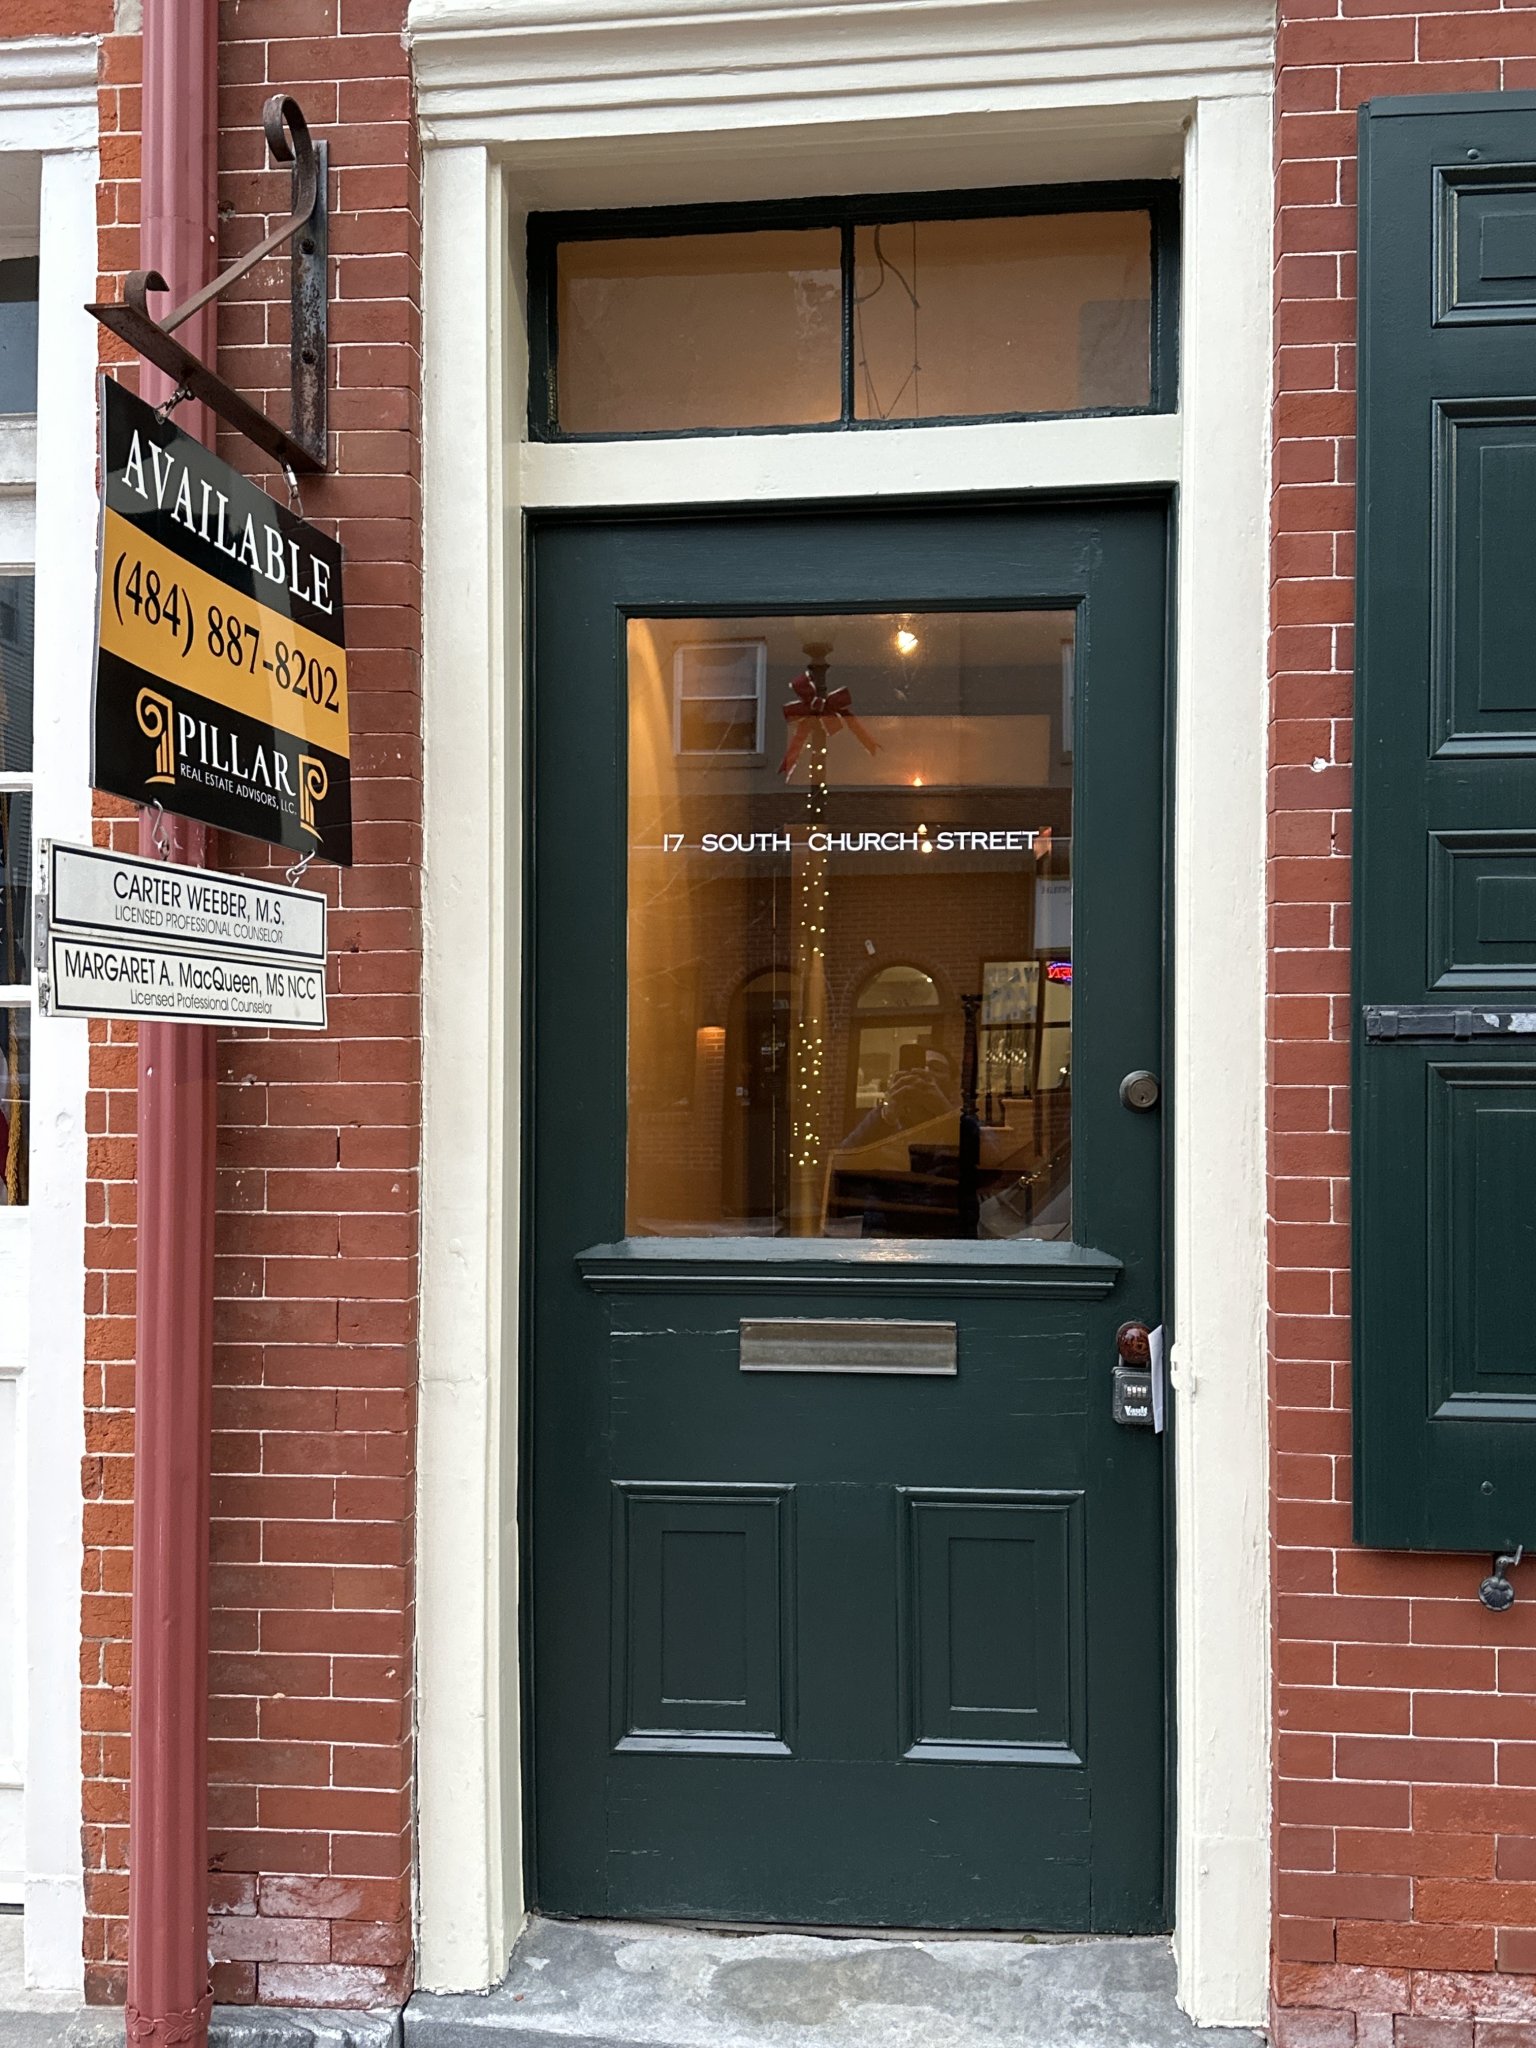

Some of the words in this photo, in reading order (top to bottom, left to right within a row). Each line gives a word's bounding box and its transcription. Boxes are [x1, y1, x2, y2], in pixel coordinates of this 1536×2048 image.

[121, 429, 333, 616] AVAILABLE
[113, 552, 194, 658] (484)
[207, 605, 340, 714] 887-8202
[177, 711, 296, 797] PILLAR
[180, 763, 203, 783] REAL
[205, 769, 234, 793] ESTATE
[236, 785, 279, 811] ADVISORS,
[280, 799, 298, 816] LLC.
[663, 833, 685, 853] 17
[701, 832, 791, 852] SOUTH
[808, 831, 919, 852] CHURCH
[936, 830, 1040, 851] STREET
[113, 871, 181, 908] CARTER
[186, 884, 251, 923] WEEBER,
[256, 898, 285, 926] M.S.
[115, 905, 163, 927] LICENSED
[166, 913, 231, 937] PROFESSIONAL
[233, 923, 283, 944] COUNSELOR
[65, 949, 155, 985] MARGARET
[159, 960, 174, 987] A.
[179, 962, 262, 997] MacQueen,
[266, 972, 285, 997] MS
[288, 976, 316, 1000] NCC
[130, 989, 175, 1008] Licensed
[177, 992, 229, 1013] Professional
[231, 997, 272, 1015] Counselor
